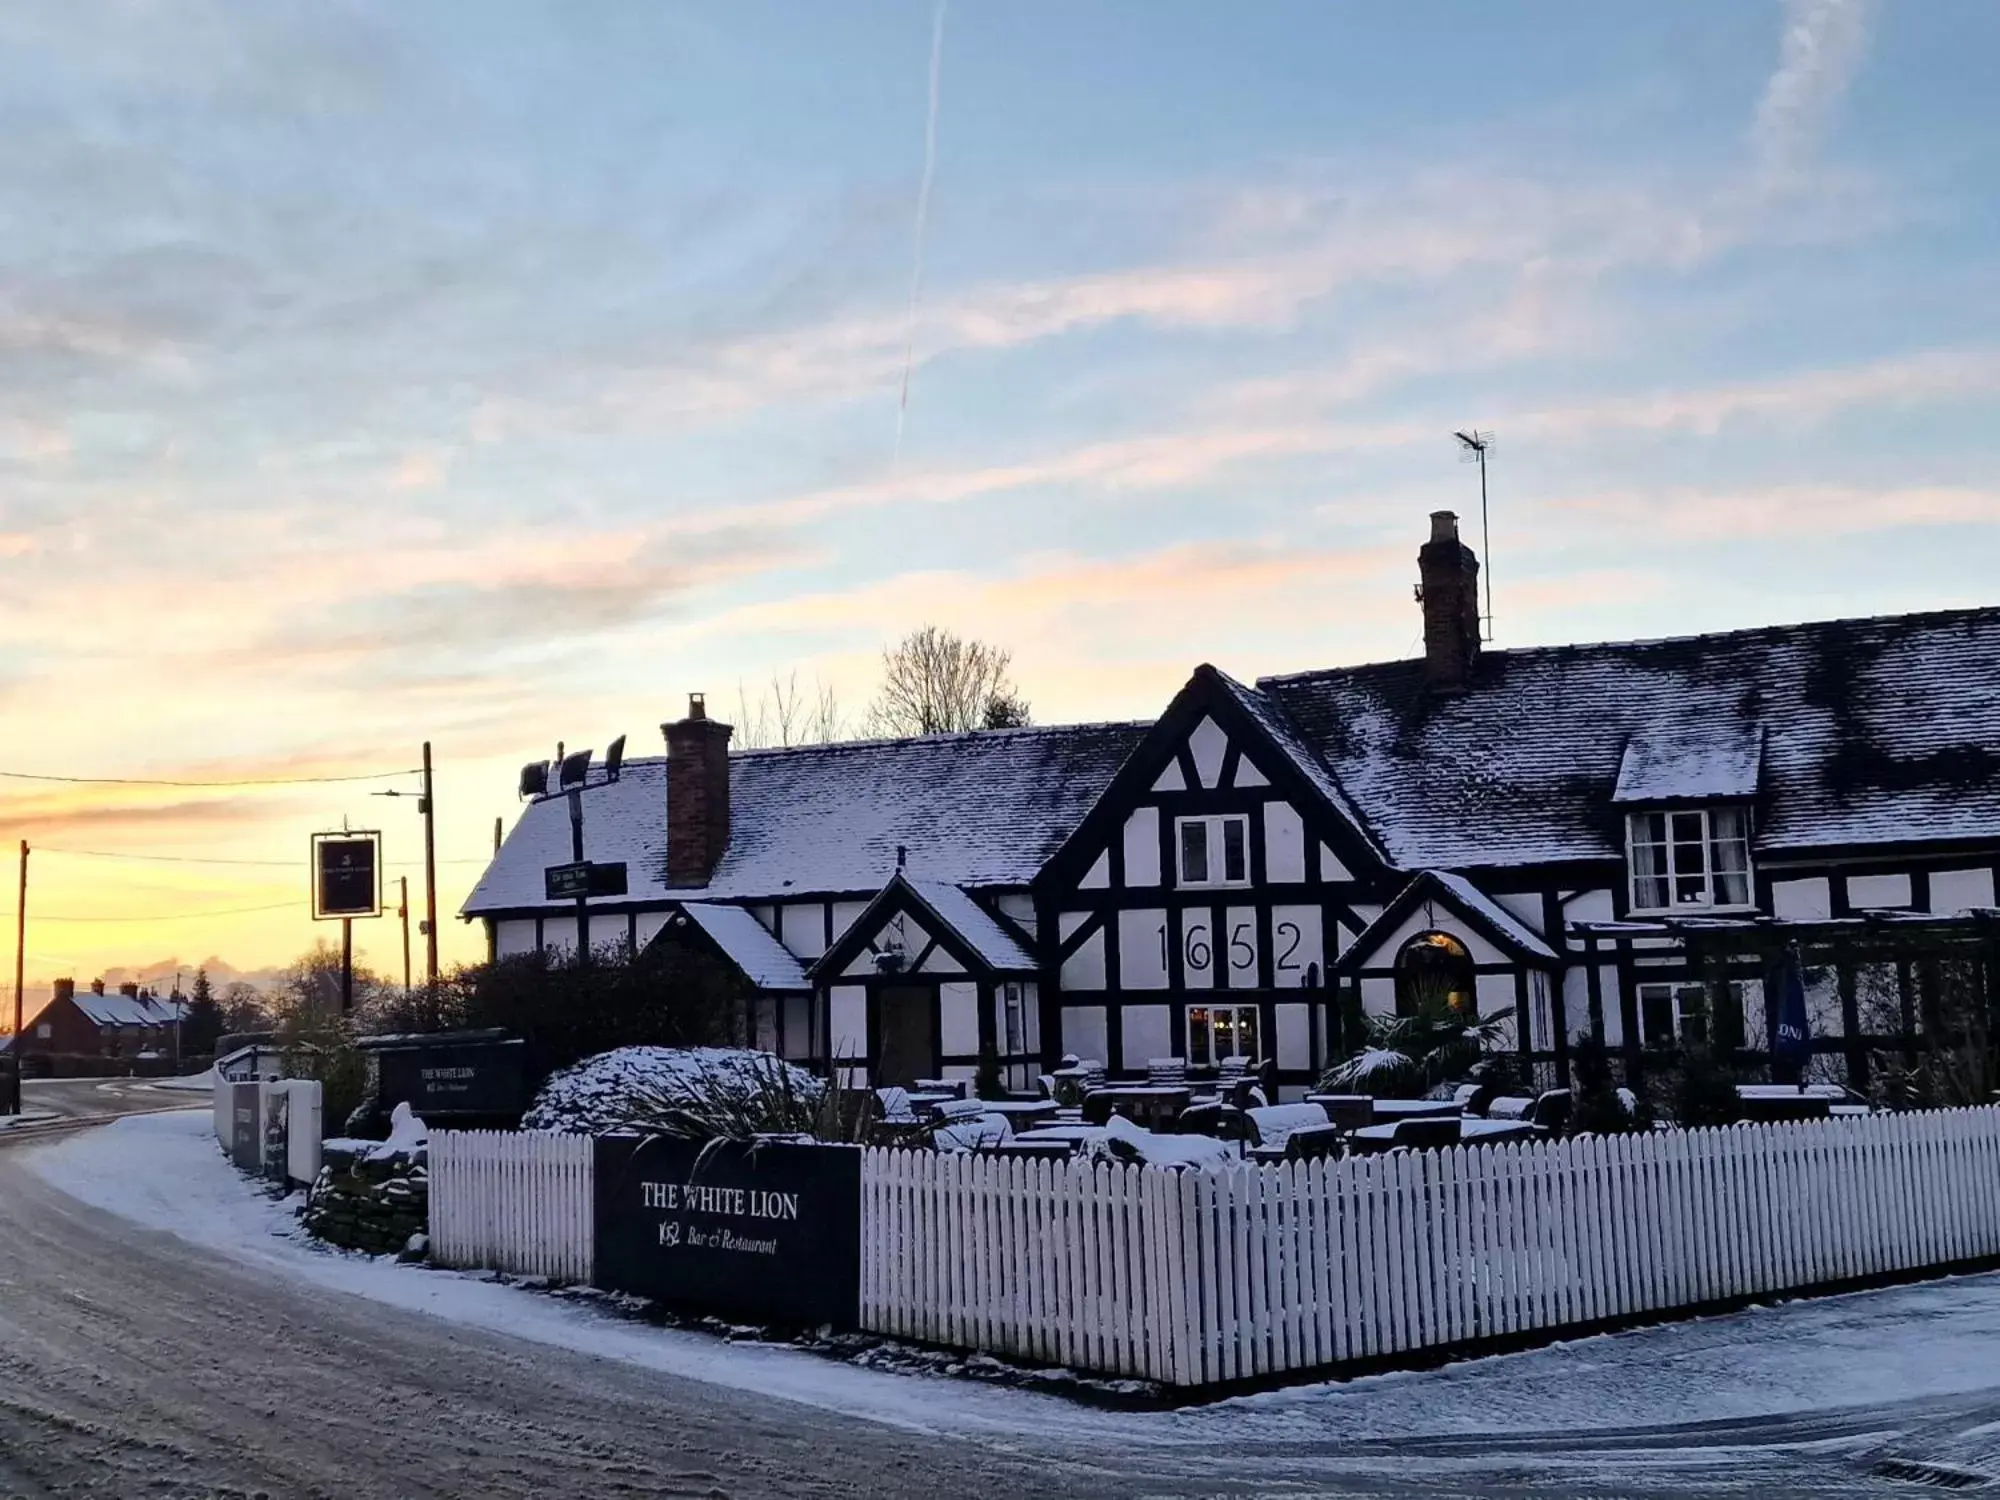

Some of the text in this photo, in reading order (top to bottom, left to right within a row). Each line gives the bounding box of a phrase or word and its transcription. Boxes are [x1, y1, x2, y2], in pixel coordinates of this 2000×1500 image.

[1157, 922, 1301, 971] 1652
[641, 1182, 799, 1220] THE WHITE LION
[687, 1225, 706, 1246] Bar
[721, 1228, 777, 1255] Restaurant
